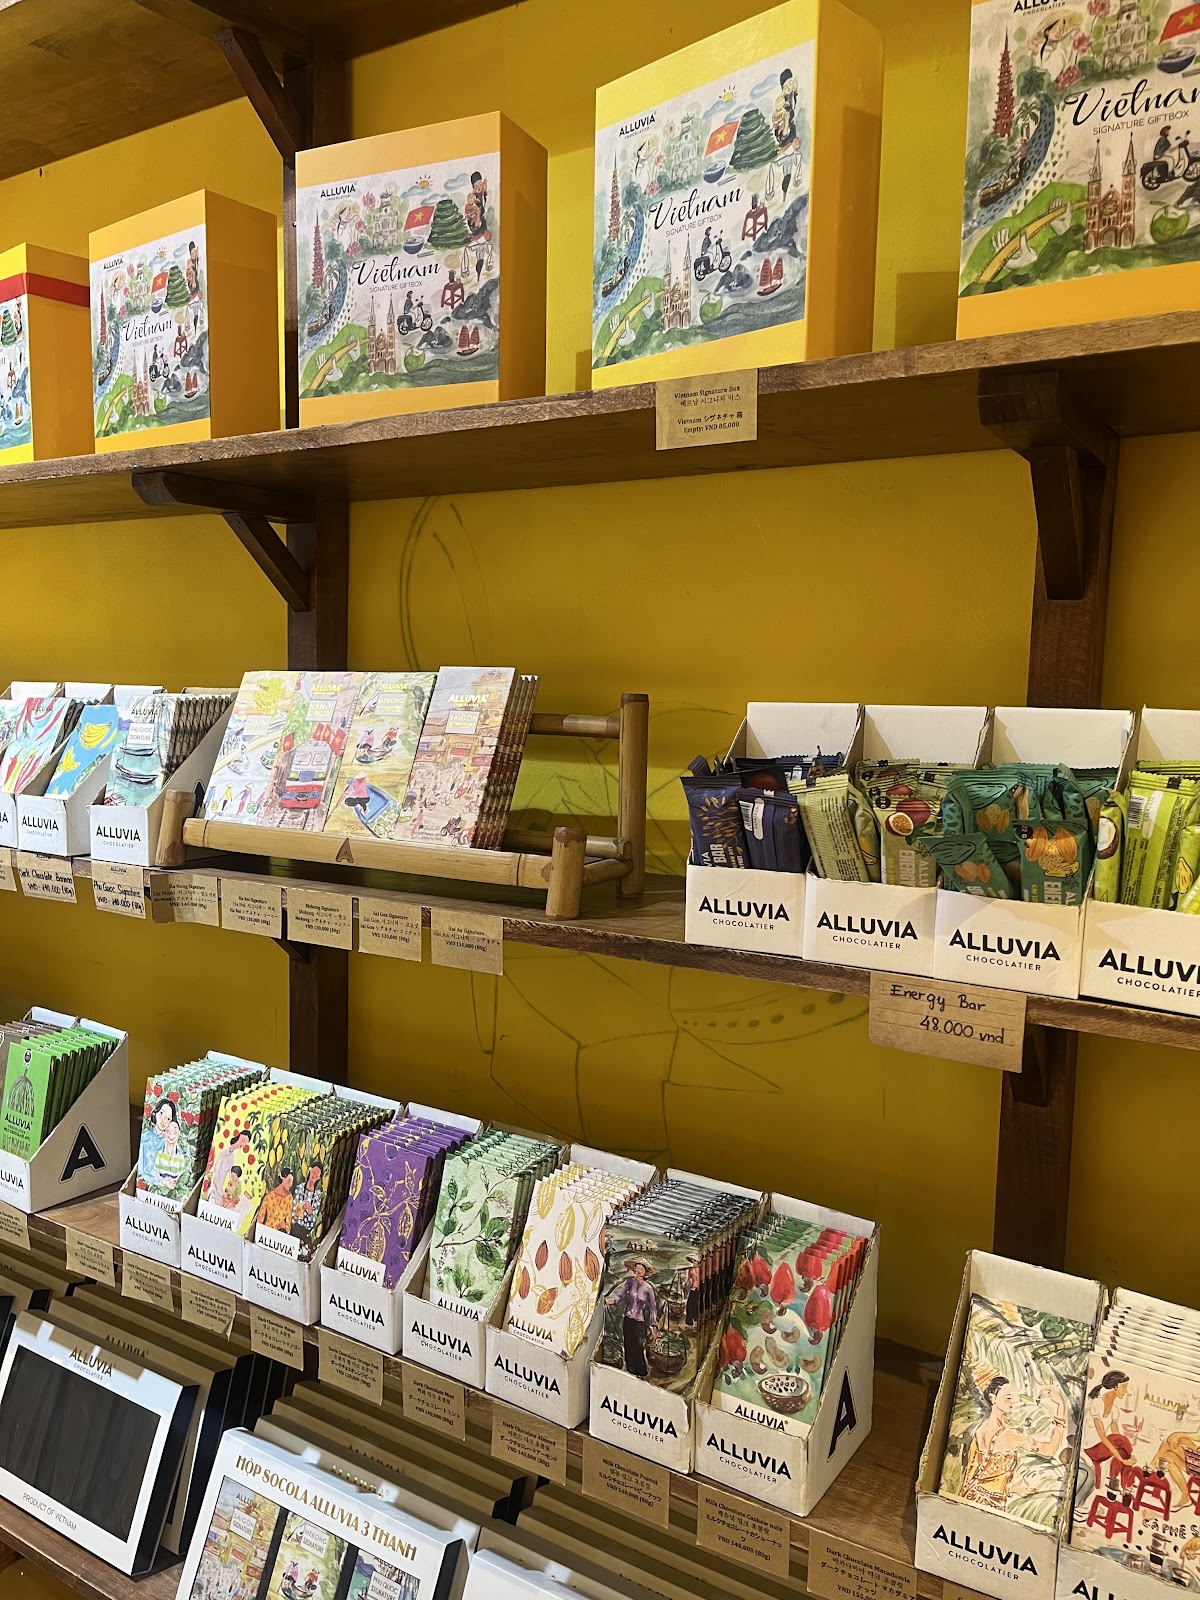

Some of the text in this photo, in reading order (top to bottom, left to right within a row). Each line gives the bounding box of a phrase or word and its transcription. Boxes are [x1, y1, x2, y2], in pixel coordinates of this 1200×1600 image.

[1093, 110, 1190, 136] SIGNATURE GIFTBOX
[649, 188, 744, 230] Vietnam
[666, 213, 722, 237] SIGNATURE GIFTBOX
[352, 256, 442, 285] Vietnam
[369, 281, 422, 293] SIGNATURE GIFTBOX
[122, 316, 172, 341] Vietnam
[700, 388, 727, 396] Signature
[22, 815, 59, 831] ALLUVIA
[96, 825, 141, 841] ALLUVIA
[710, 844, 727, 863] BAR
[94, 880, 102, 890] Phu
[699, 896, 789, 921] ALLUVIA
[713, 919, 774, 930] CHOCOLATIER
[817, 911, 918, 940] ALLUVIA
[832, 936, 901, 949] CHOCOLATIER
[949, 929, 1061, 961] ALLUVIA
[966, 955, 1041, 971] CHOCOLATIER
[890, 984, 986, 1012] Energy Bar
[920, 1015, 1004, 1044] 48.000 vnd
[5, 1113, 31, 1130] ALLUVIA
[60, 1123, 107, 1184] A
[125, 1215, 170, 1241] ALLUVIA
[200, 1210, 232, 1231] ALLUVIA
[133, 1232, 163, 1246] CHOCOLATIER
[258, 1235, 293, 1257] ALLUVIA
[188, 1244, 236, 1275] ALLUVIA
[195, 1262, 228, 1279] CHOCOLATIER
[339, 1259, 377, 1282] ALLUVIA
[249, 1265, 300, 1297] ALLUVIA
[256, 1284, 291, 1301] CHOCOLATIER
[329, 1293, 385, 1327] ALLUVIA
[338, 1311, 376, 1331] CHOCOLATIER
[437, 1298, 479, 1321] ALLUVIA
[411, 1320, 472, 1357] ALLUVIA
[508, 1315, 553, 1342] ALLUVIA
[513, 1329, 544, 1345] CHOCOLATIER
[70, 1347, 112, 1377] ALLUVIA
[421, 1340, 462, 1361] CHOCOLATIER
[74, 1364, 103, 1380] CHOCOLATIER
[494, 1354, 561, 1395] ALLUVIA
[413, 1380, 423, 1388] Dark
[424, 1384, 444, 1395] Chocolate
[505, 1375, 549, 1399] CHOCOLATIER
[600, 1395, 677, 1438] ALLUVIA
[735, 1404, 785, 1431] ALLUVIA
[828, 1367, 857, 1462] A
[502, 1421, 556, 1447] Dark Chocolate Almond
[612, 1418, 664, 1444] CHOCOLATIER
[507, 1445, 517, 1453] VND
[707, 1433, 791, 1480] ALLUVIA
[603, 1458, 658, 1485] Milk Chocolate Peanut
[720, 1456, 777, 1484] CHOCOLATIER
[606, 1483, 617, 1491] VND
[23, 1493, 77, 1531] PRODUCT OF VIETNAM
[234, 1512, 256, 1527] SAIGON
[235, 1455, 418, 1562] HỘP SOCOLA ALLUVIA 3 THANH
[706, 1498, 782, 1532] Milk Chocolate Cashew nuts
[233, 1520, 253, 1536] SIGNATURE
[304, 1528, 328, 1544] MEKONG
[1142, 1518, 1159, 1531] CÀ
[1162, 1524, 1186, 1539] PHÊ
[303, 1537, 324, 1553] SIGNATURE
[718, 1535, 771, 1561] VND 140,000 (80g)
[933, 1524, 1038, 1576] ALLUVIA
[821, 1561, 879, 1588] ダークチョコレート
[826, 1548, 910, 1583] Dark Chocolate Macadamia
[948, 1550, 1020, 1580] CHOCOLATIER
[372, 1576, 398, 1594] PHU QUOC
[837, 1585, 850, 1594] VND
[857, 1585, 877, 1596] ナッツ
